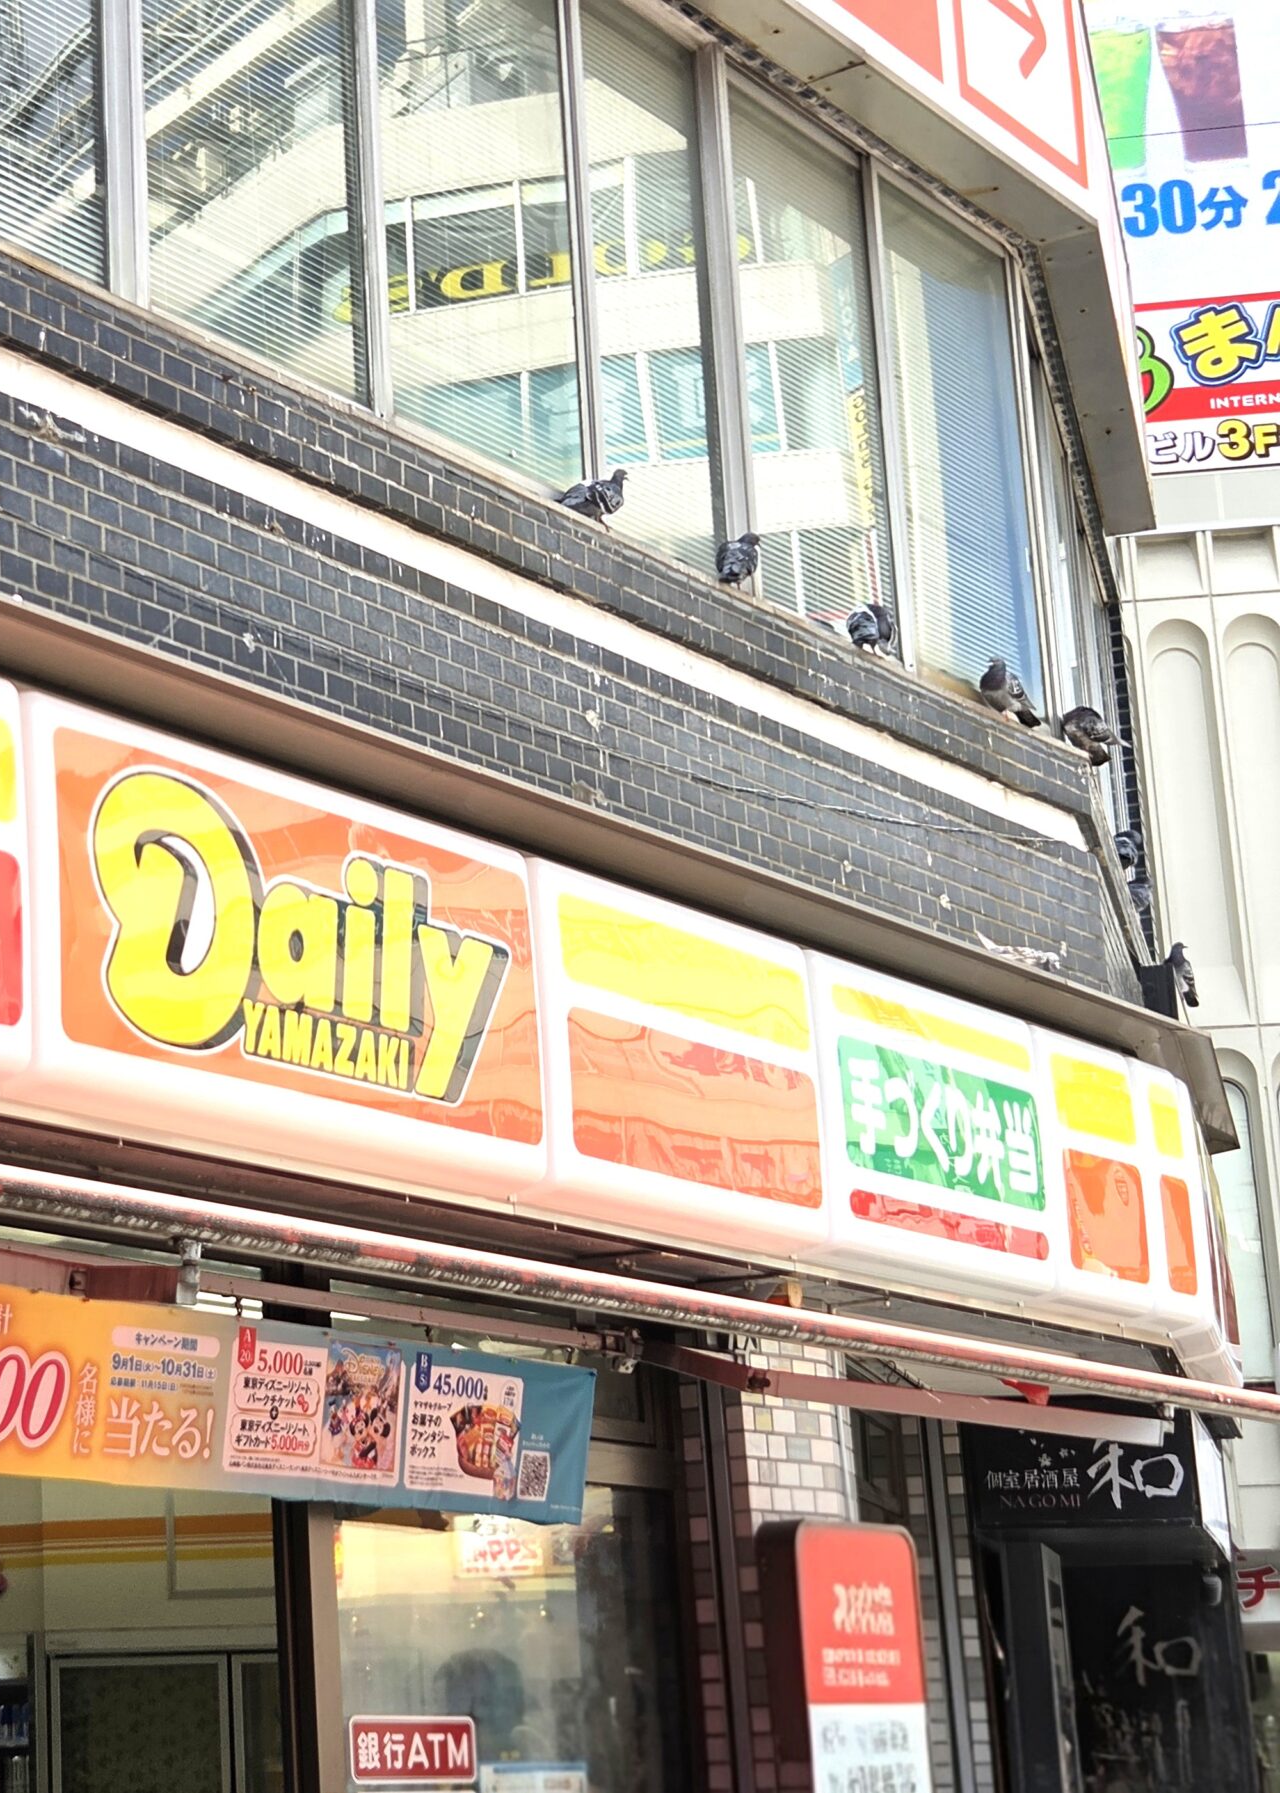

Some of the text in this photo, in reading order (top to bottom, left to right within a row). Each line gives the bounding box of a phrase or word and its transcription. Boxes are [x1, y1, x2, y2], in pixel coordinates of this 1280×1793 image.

[1121, 179, 1249, 238] 30分
[1173, 303, 1280, 387] ま
[91, 768, 510, 1104] Daily
[243, 997, 412, 1091] YAMAZAKI
[257, 1348, 304, 1376] 5,000
[433, 1373, 483, 1400] 45,000
[72, 1363, 102, 1457] 名様に
[247, 1392, 297, 1408] パークチケット
[984, 1467, 1081, 1491] 個室居酒屋
[1086, 1439, 1184, 1510] 和
[357, 1731, 469, 1771] 銀行ATM
